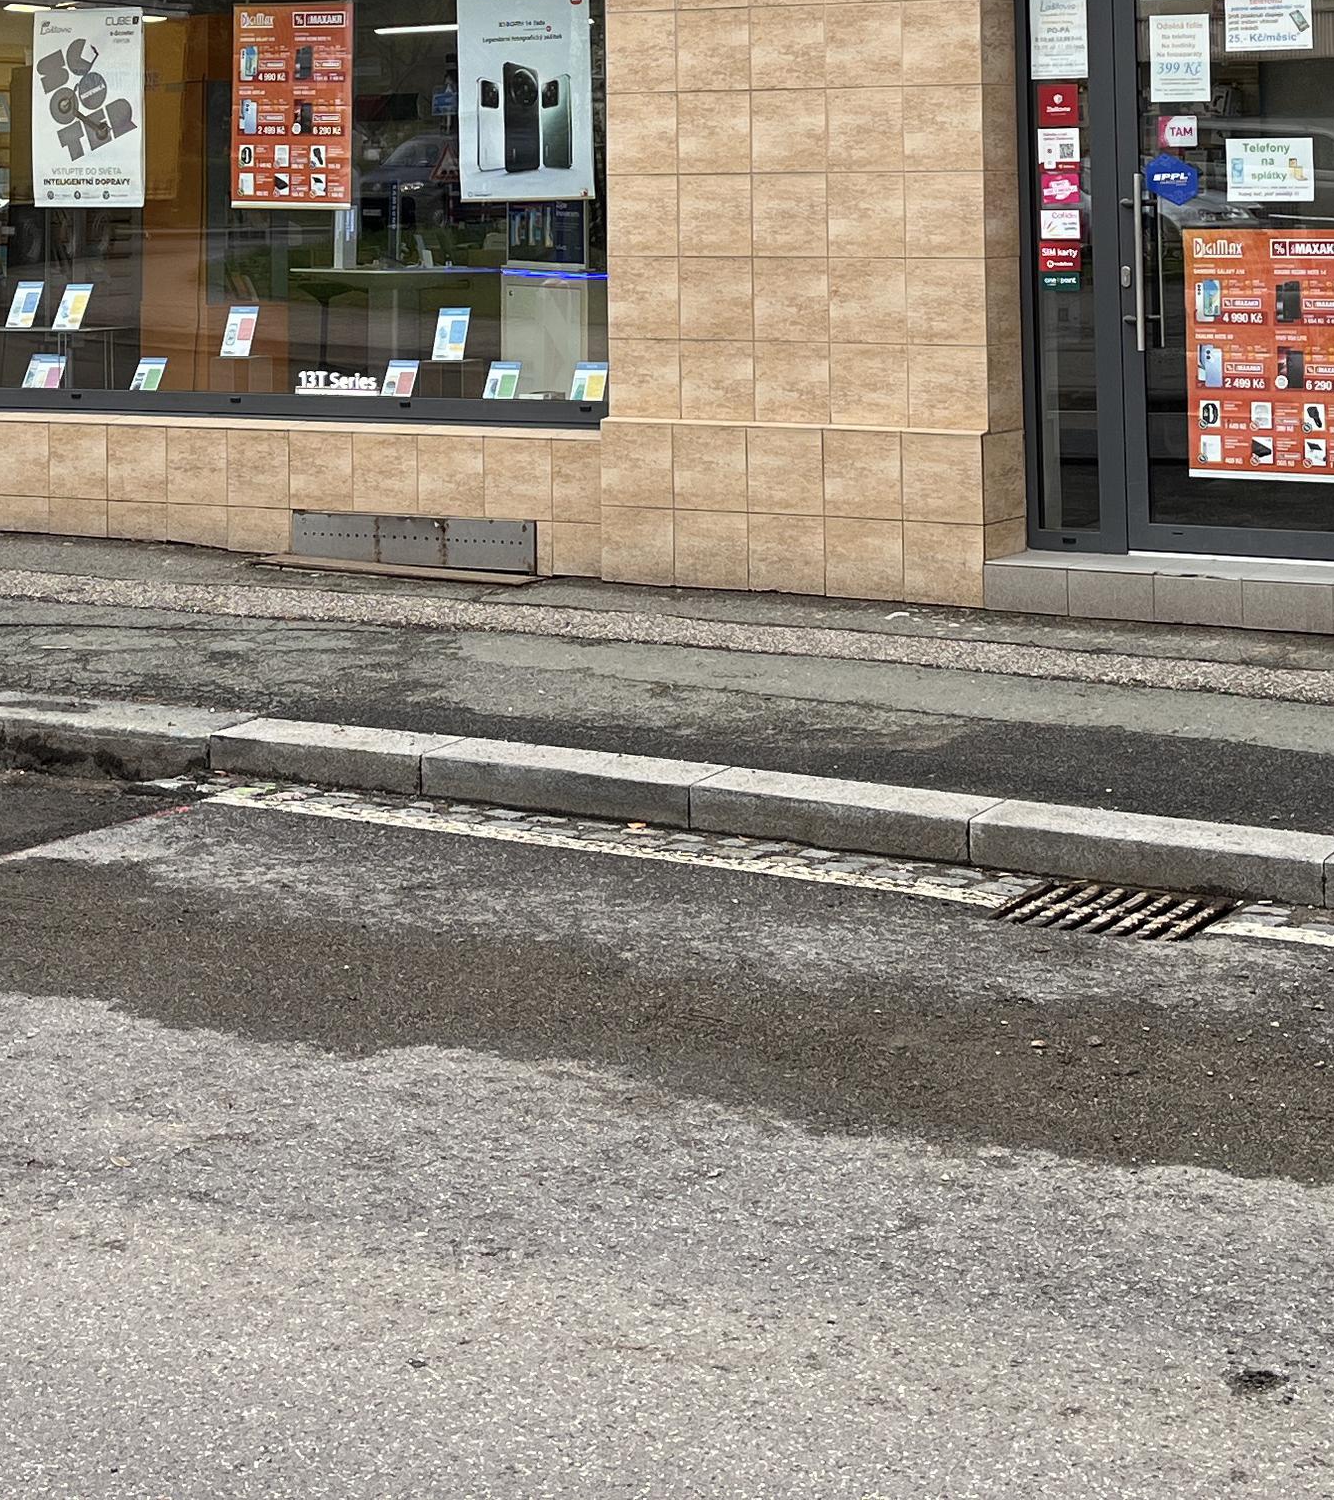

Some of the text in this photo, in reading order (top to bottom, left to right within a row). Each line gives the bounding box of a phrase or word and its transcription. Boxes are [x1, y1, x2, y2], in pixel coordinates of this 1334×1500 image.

[1156, 61, 1181, 75] 399
[1169, 126, 1193, 137] TAM
[1242, 142, 1291, 155] Telefony
[1261, 157, 1275, 166] na
[1161, 172, 1189, 181] PPL
[1251, 171, 1288, 182] splátky
[1041, 247, 1078, 259] SIM karty
[1273, 243, 1286, 255] %
[1222, 312, 1263, 324] 4 990 Kč
[298, 370, 377, 390] 13T Series
[1224, 378, 1265, 389] 2 499 Kč
[1305, 380, 1313, 390] 6
[1314, 380, 1333, 391] 290
